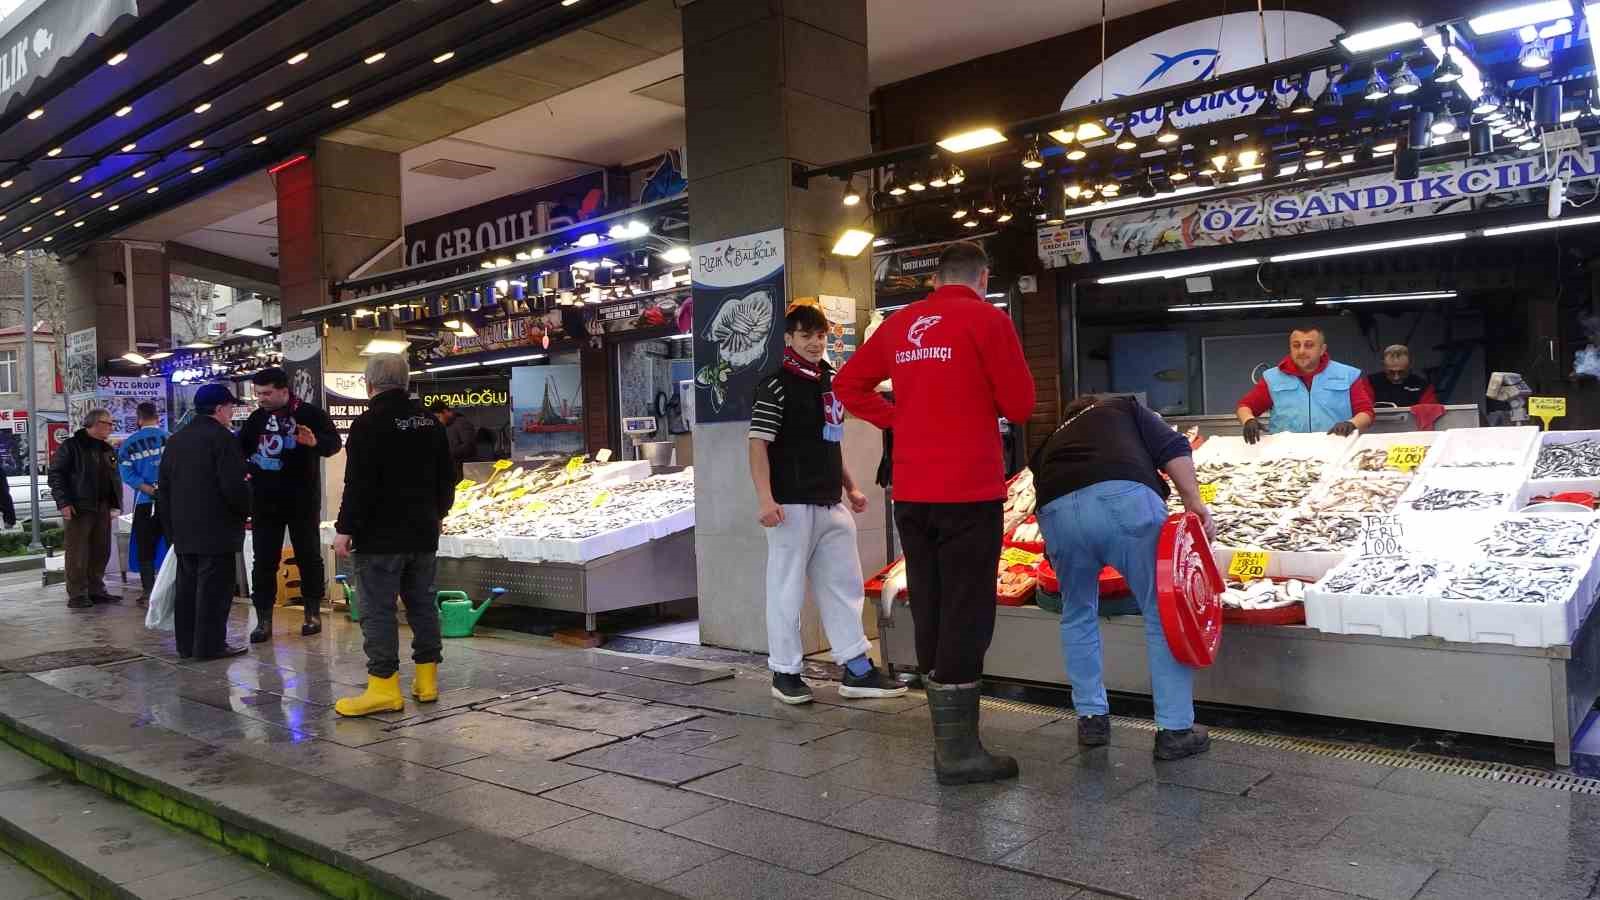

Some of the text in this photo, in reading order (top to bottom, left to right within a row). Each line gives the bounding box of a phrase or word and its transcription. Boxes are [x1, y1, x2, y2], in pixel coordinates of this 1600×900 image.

[0, 36, 29, 93] LIK
[1203, 206, 1259, 232] ÖZ
[131, 381, 161, 389] GROUP
[329, 405, 347, 416] BUZ
